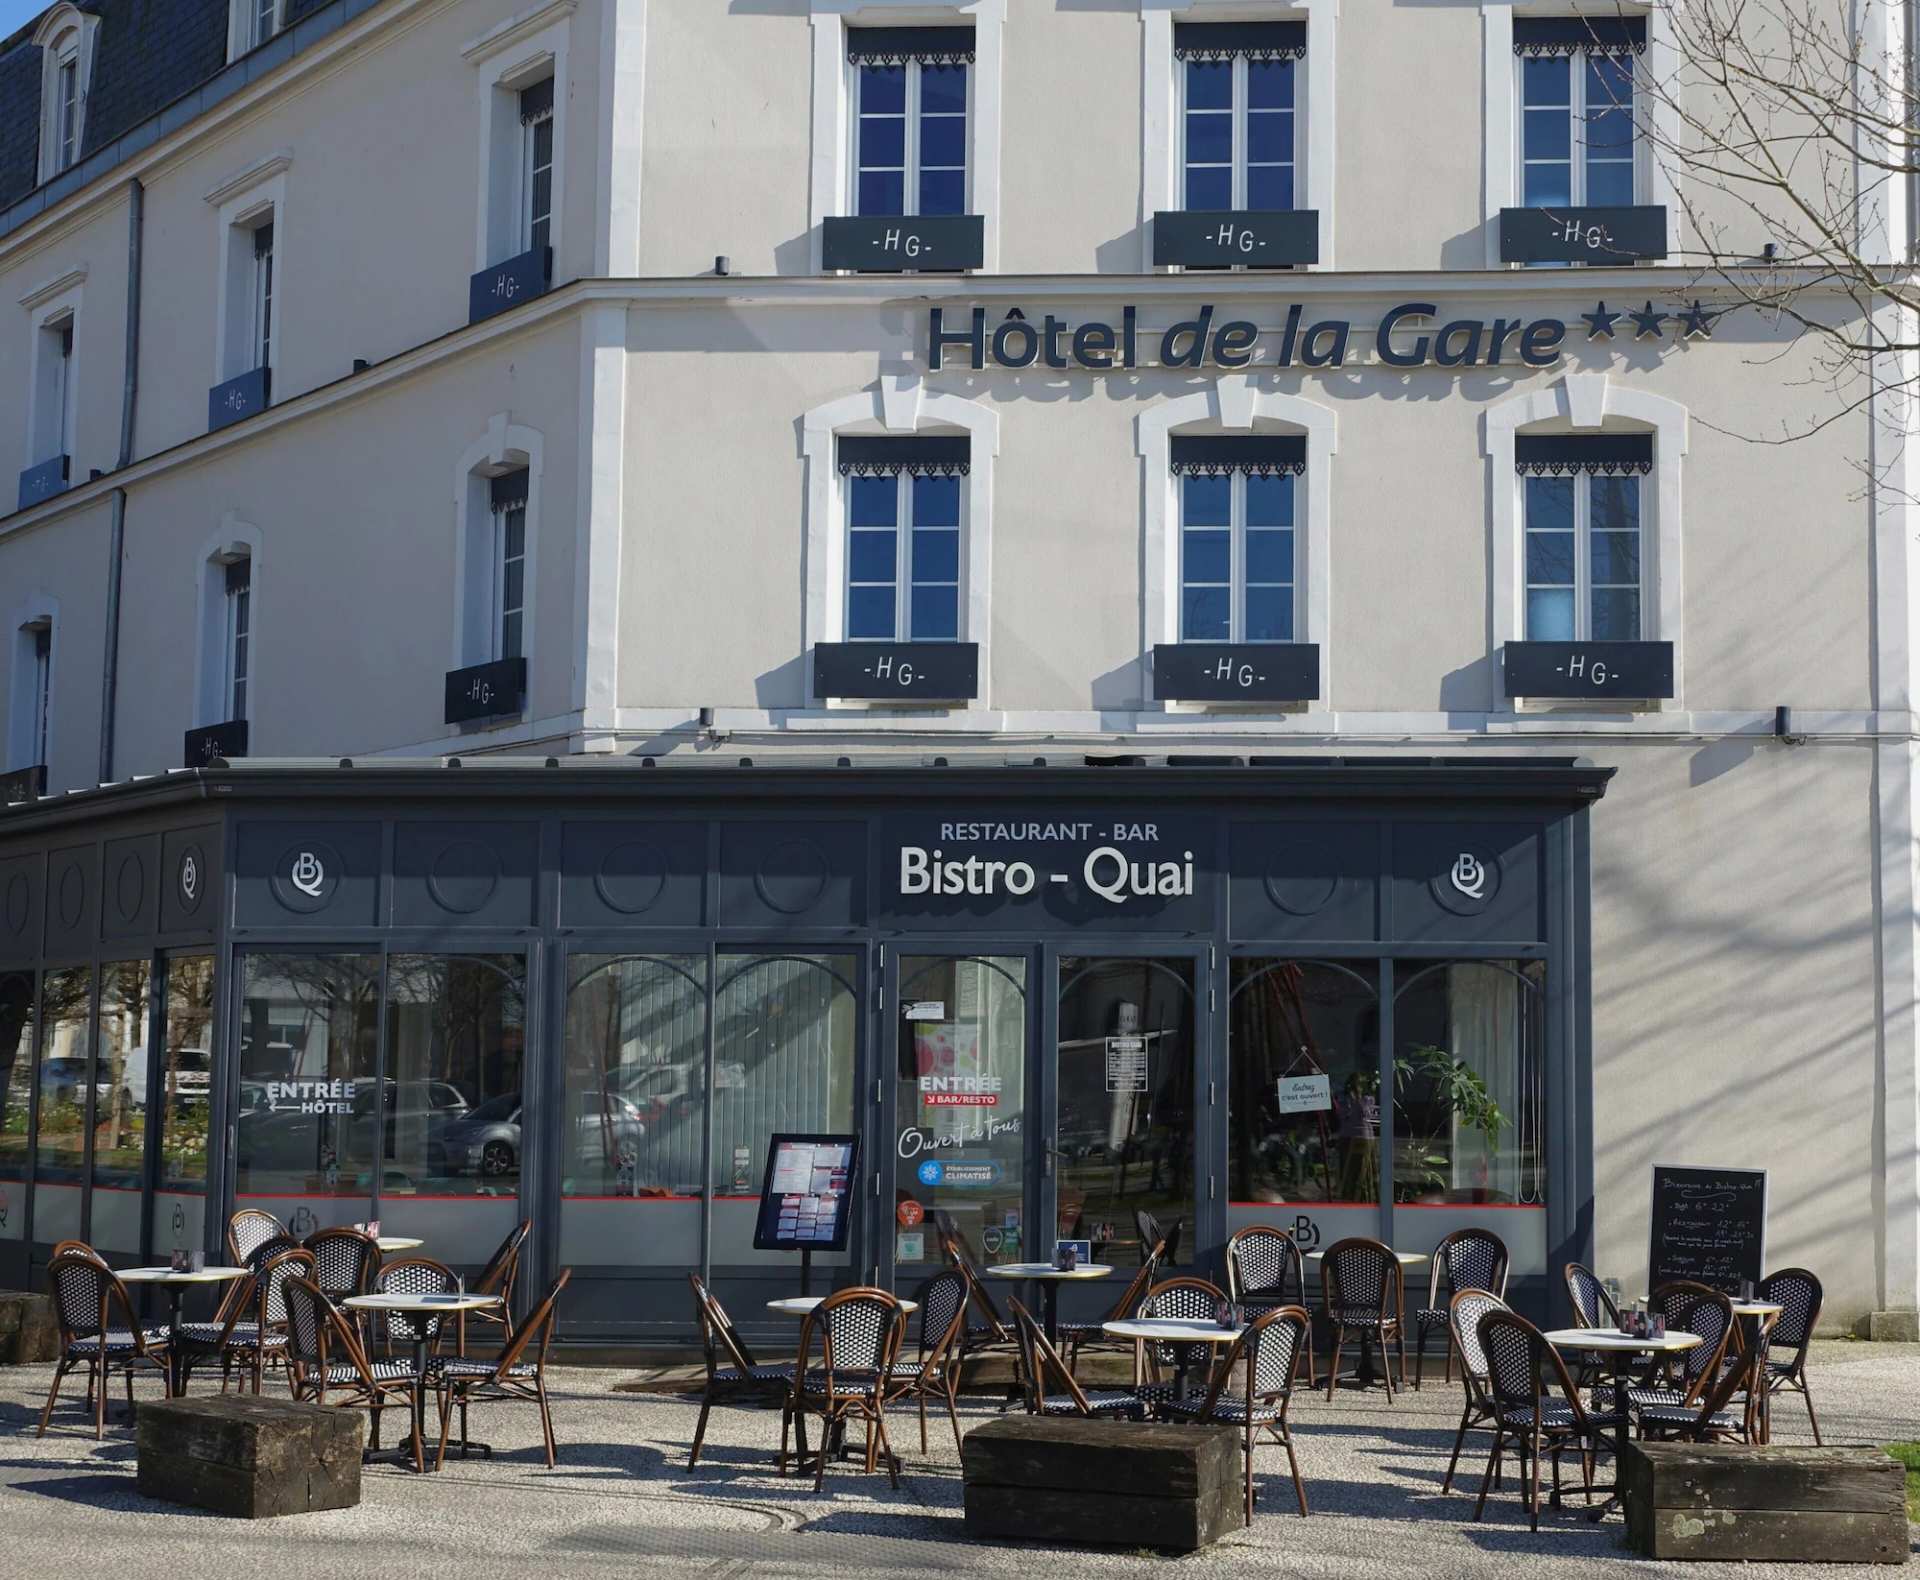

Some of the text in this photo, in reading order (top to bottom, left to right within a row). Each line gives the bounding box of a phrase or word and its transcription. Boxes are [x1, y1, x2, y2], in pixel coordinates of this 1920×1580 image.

[928, 303, 1567, 370] Hôtel de la Gare
[941, 823, 1093, 841] RESTAURANT
[1113, 823, 1160, 841] BAR
[900, 846, 1036, 896] Bistro
[1083, 846, 1194, 904] Quai
[267, 1078, 356, 1098] ENTRÉE
[919, 1072, 1002, 1091] ENTRÉE
[301, 1100, 355, 1114] HÔTEL
[936, 1095, 996, 1104] BAR/RESTO
[898, 1121, 970, 1159] Ouvert
[944, 1171, 993, 1181] CLIMATISÉ
